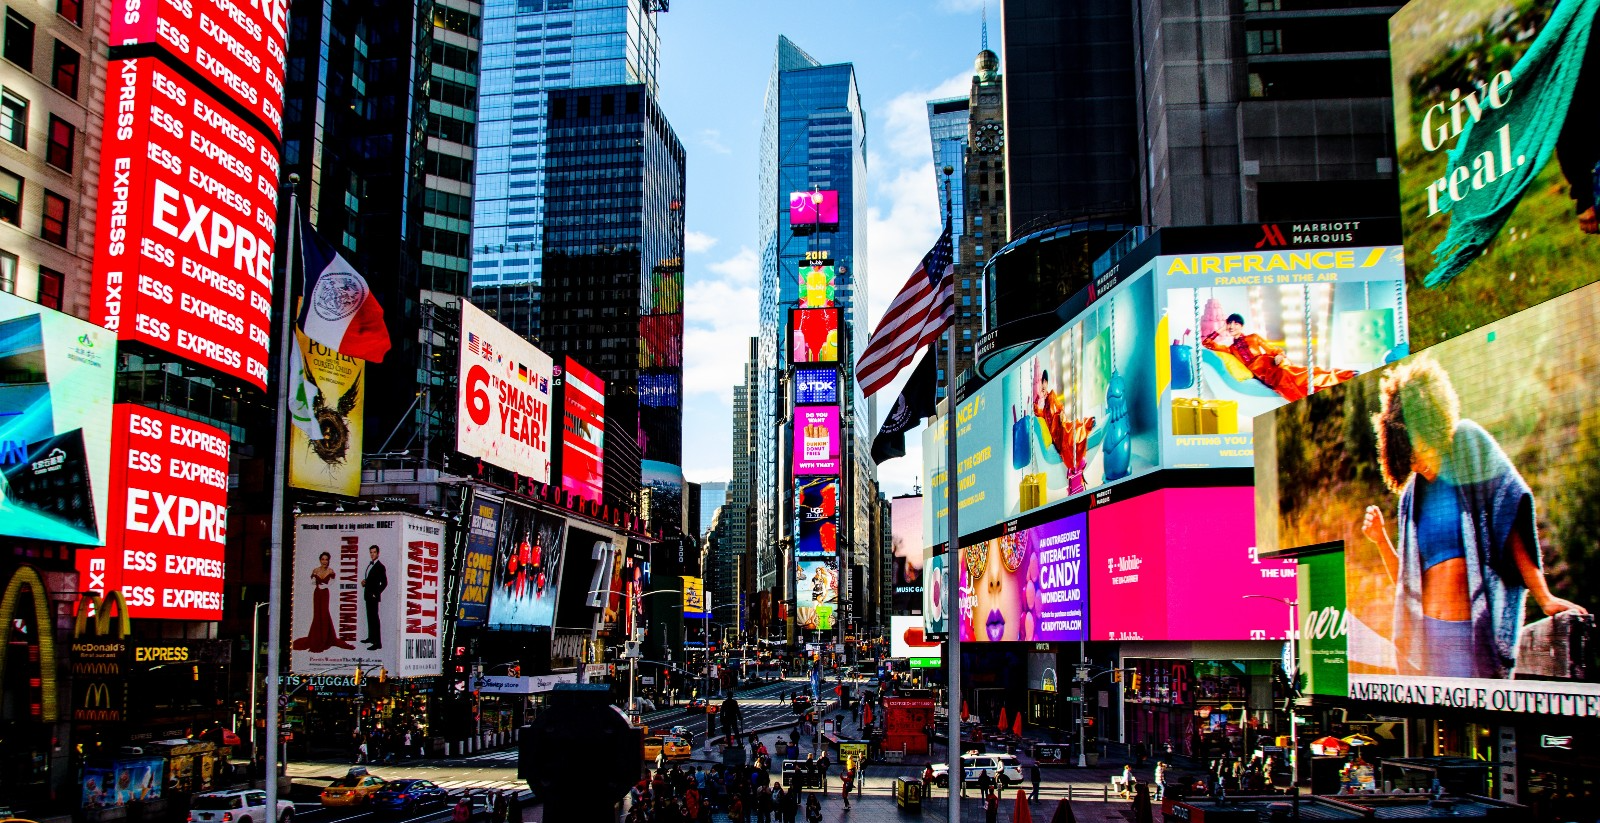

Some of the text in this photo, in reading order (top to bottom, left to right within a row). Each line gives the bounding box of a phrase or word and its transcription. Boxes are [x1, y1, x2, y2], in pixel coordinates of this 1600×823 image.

[199, 12, 261, 74] EXPRESS
[157, 17, 258, 105] ESS EXPRESS
[152, 70, 256, 154] ESS EXPRESS
[1421, 70, 1513, 152] Give
[150, 105, 253, 183] ESS EXPRESS
[147, 141, 252, 217] ESS EXPRESS
[1425, 123, 1526, 218] real.
[108, 157, 131, 257] EXPRESS
[1292, 221, 1361, 233] MARRIOTT
[1292, 233, 1354, 244] MARQUIS
[805, 250, 828, 260] 2018
[1167, 250, 1355, 276] AIRFRANCE
[141, 237, 245, 301] ESS EXPRESS
[1097, 264, 1120, 287] MARRIOTT
[1215, 272, 1338, 286] FRANCE IS IN THE AIR
[1097, 276, 1117, 297] MARQUIS
[104, 271, 123, 333] EXPR
[138, 274, 245, 335] ESS EXPRESS
[136, 313, 242, 370] ESS EXPRESS
[314, 359, 335, 370] CURSED
[552, 378, 562, 386] LG
[807, 381, 834, 391] TDK
[498, 381, 541, 422] SMASH
[169, 424, 227, 456] EXPRESS
[498, 402, 548, 453] YEAR!
[1175, 436, 1247, 446] PUTTING YOU
[973, 446, 992, 466] CENTER
[169, 458, 226, 487] EXPRESS
[514, 472, 648, 535] 1540 BROADWAY
[1040, 529, 1081, 549] AN OUTRAGEOUSLY
[340, 536, 359, 583] PRETTY
[467, 551, 493, 571] COME
[1040, 543, 1081, 565] INTERACTIVE
[165, 555, 222, 580] EXPRESS
[1040, 559, 1081, 590] CANDY
[1260, 568, 1280, 578] THE
[162, 588, 221, 610] EXPRESS
[406, 541, 424, 634] WOMAN
[421, 541, 440, 638] PRETTY
[462, 584, 489, 604] AWAY
[1040, 588, 1081, 604] WONDERLAND
[339, 590, 358, 642] WOMAN
[1041, 619, 1082, 631] CANDYTOPIA.COM
[72, 643, 126, 652] McDonald's
[135, 647, 189, 662] EXPRESS
[405, 638, 437, 659] THE MUSICAL
[1350, 682, 1427, 705] AMERICAN
[1433, 686, 1488, 710] EAGLE
